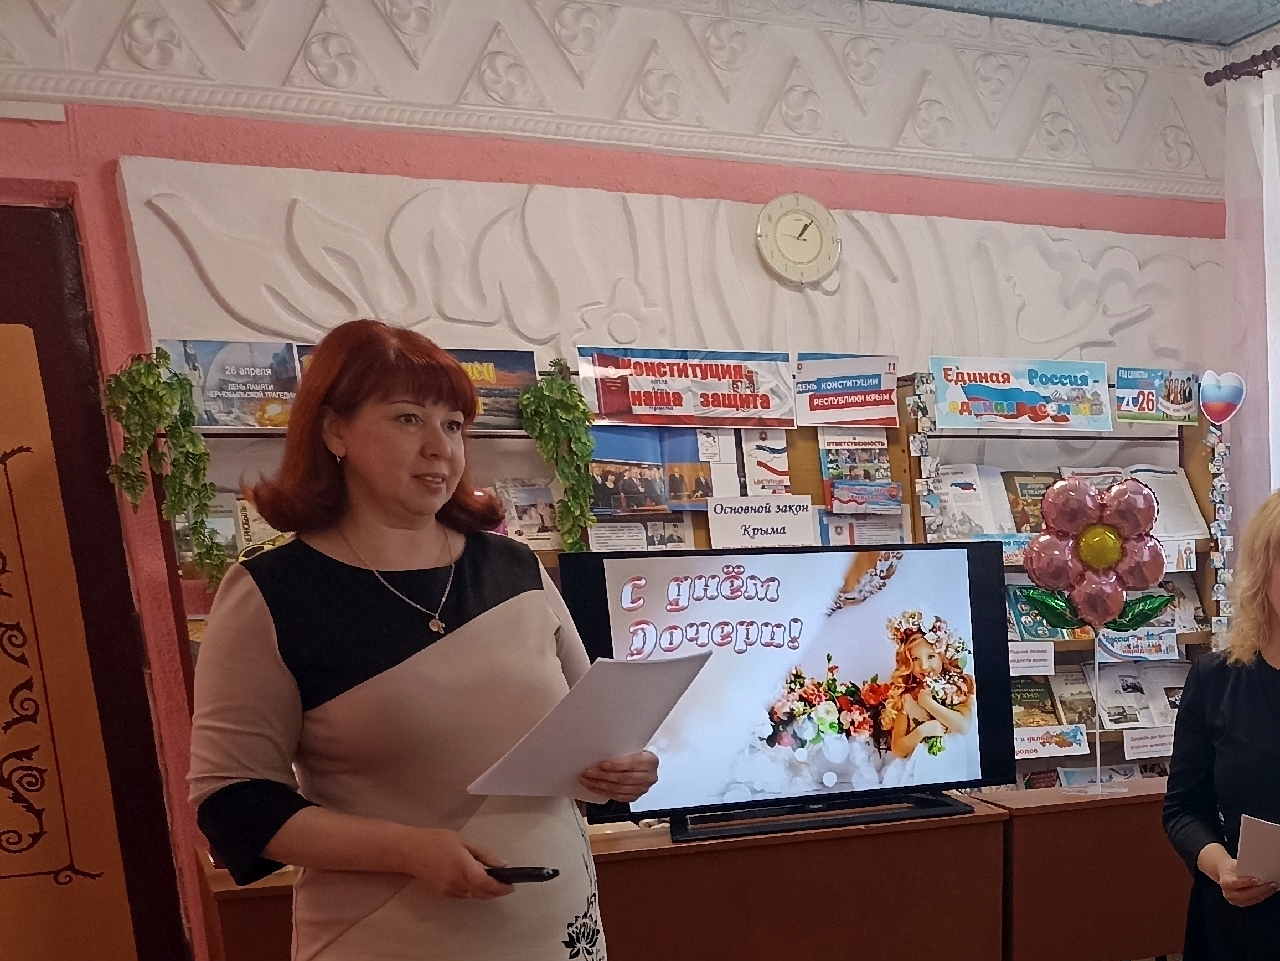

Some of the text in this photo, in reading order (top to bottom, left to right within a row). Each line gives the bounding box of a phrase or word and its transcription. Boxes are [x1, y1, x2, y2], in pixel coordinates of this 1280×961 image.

[225, 366, 272, 377] 26 апреля
[619, 357, 745, 381] Конституция
[942, 366, 1011, 386] Единая
[1027, 368, 1089, 387] Россия
[796, 378, 879, 392] ДЕНЬ КОНСТИТУЦИИ
[630, 390, 771, 412] наша защита
[813, 393, 890, 406] РЕСПУБЛИКИ КРЫМ
[948, 400, 1092, 416] единая семья
[713, 502, 809, 516] Основной закон
[740, 524, 787, 540] Крыма
[620, 564, 781, 612] С днём
[625, 617, 804, 661] Дочери!
